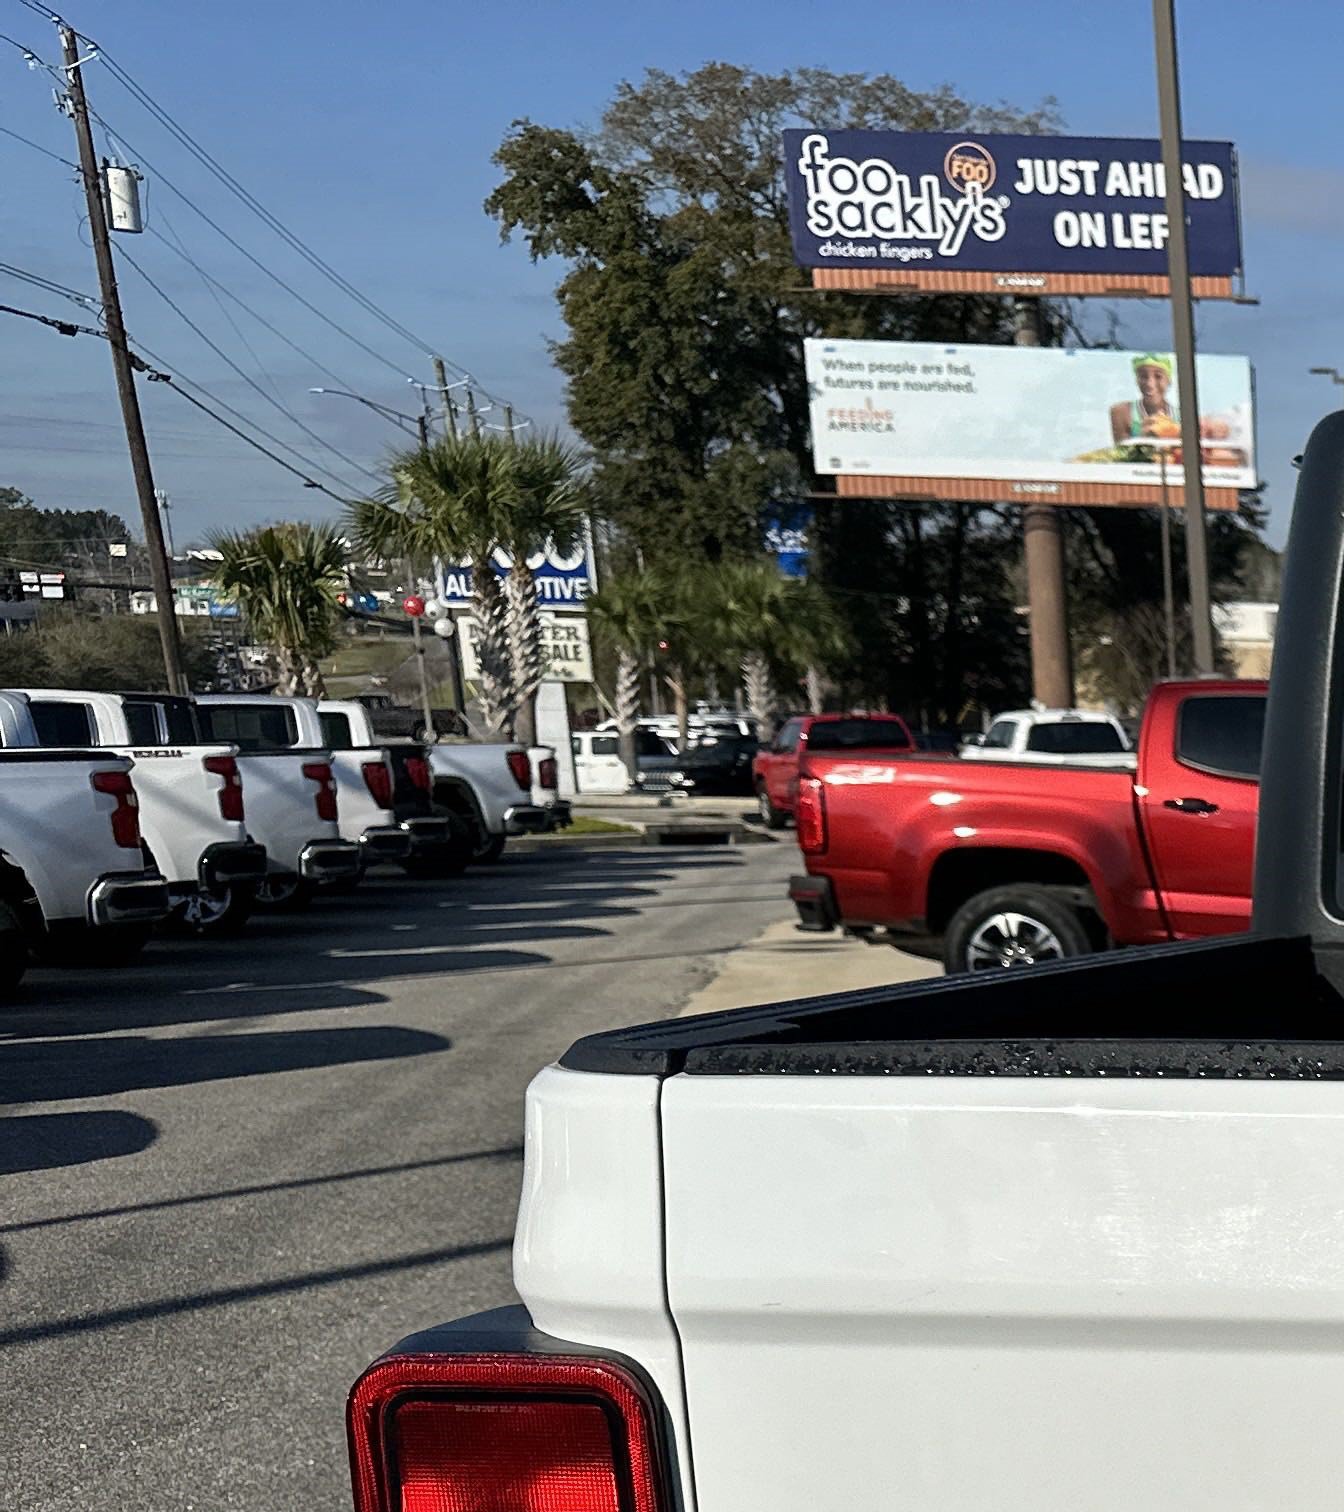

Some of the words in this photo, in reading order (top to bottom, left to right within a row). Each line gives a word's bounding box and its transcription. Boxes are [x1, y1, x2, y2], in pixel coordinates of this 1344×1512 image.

[803, 138, 894, 197] foo
[1014, 157, 1100, 197] JUST
[1053, 210, 1107, 249] ON
[1111, 211, 1192, 250] LEF
[818, 240, 878, 259] chicken
[880, 242, 934, 262] fingers
[822, 358, 865, 372] When
[868, 360, 917, 375] people
[920, 364, 944, 375] are
[877, 381, 900, 391] are
[445, 573, 591, 600] AUTIVE
